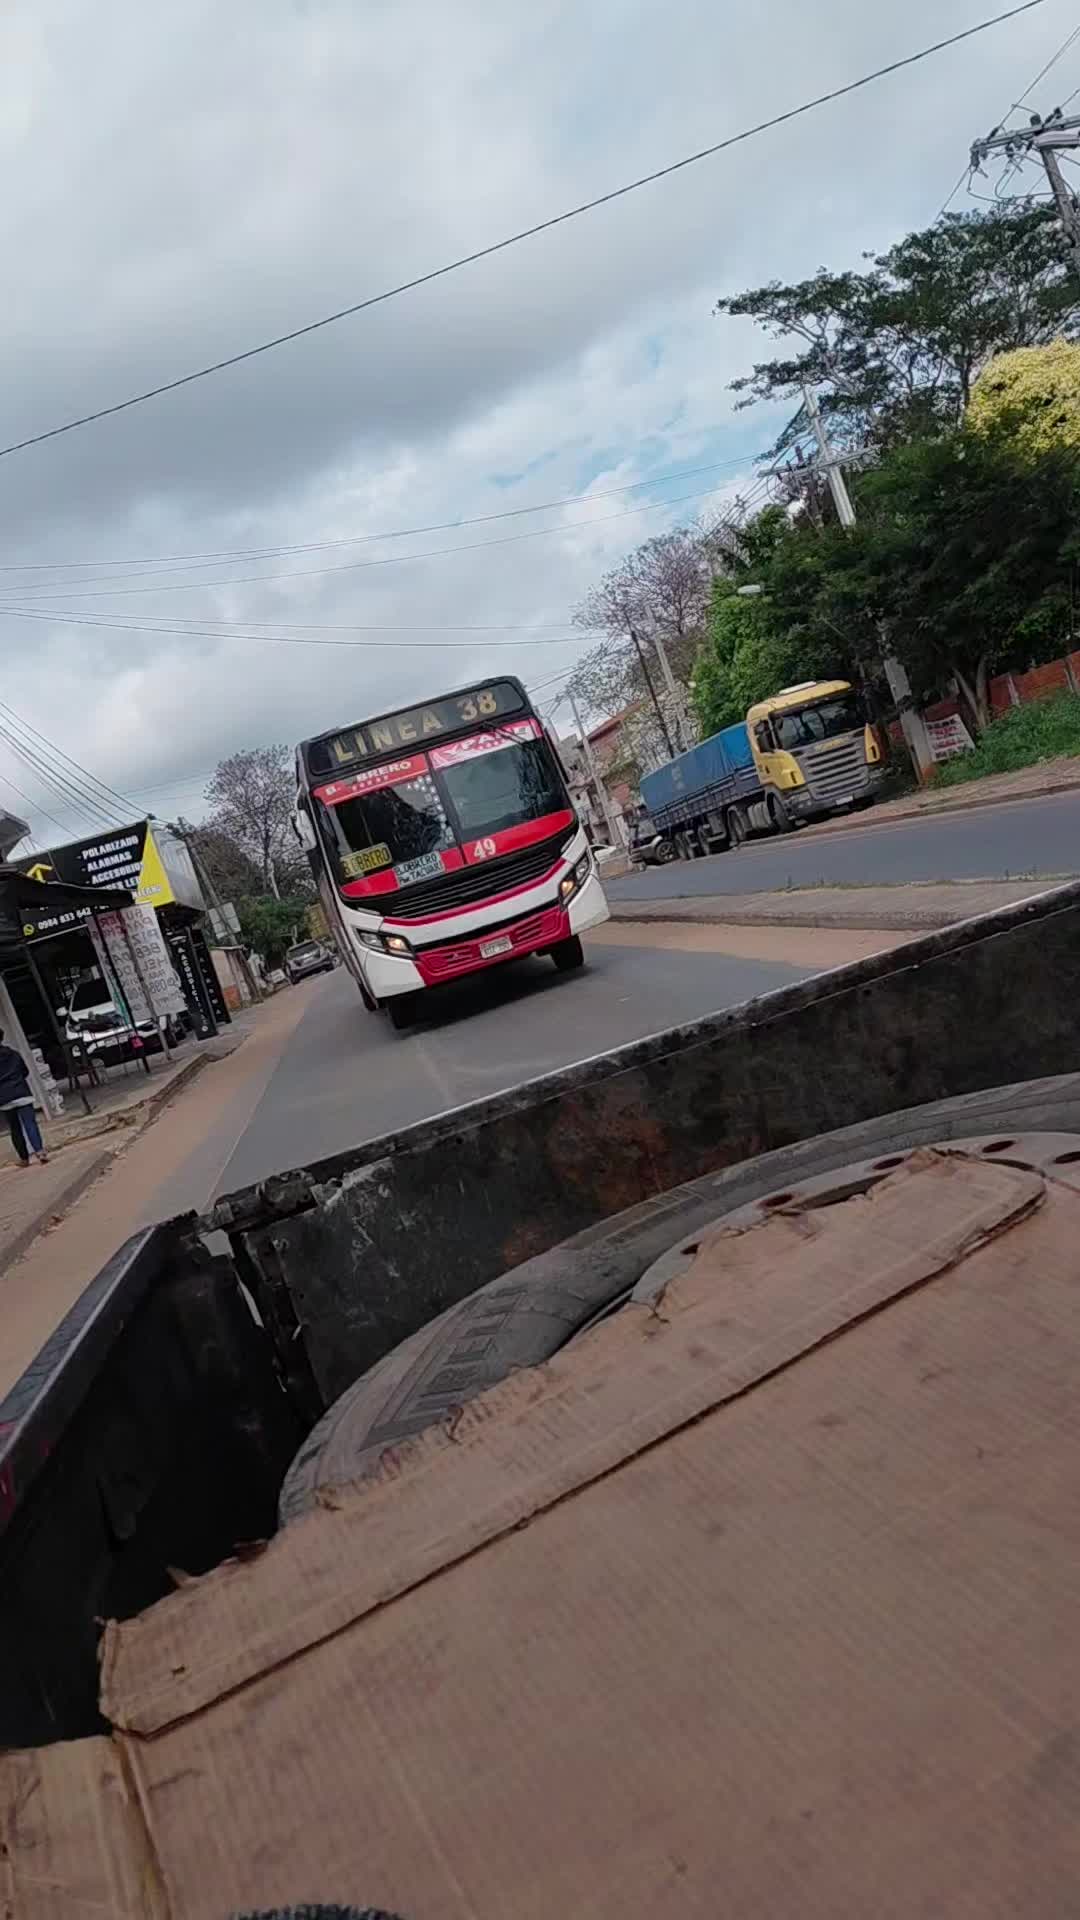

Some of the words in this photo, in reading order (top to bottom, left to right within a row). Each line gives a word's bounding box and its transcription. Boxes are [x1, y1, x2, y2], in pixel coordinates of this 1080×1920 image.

[333, 708, 443, 763] LINEA
[456, 689, 497, 721] 38
[350, 760, 412, 782] BRERO
[81, 834, 139, 860] POLARIZADO
[473, 838, 496, 858] 49
[87, 851, 133, 872] ALARMAS
